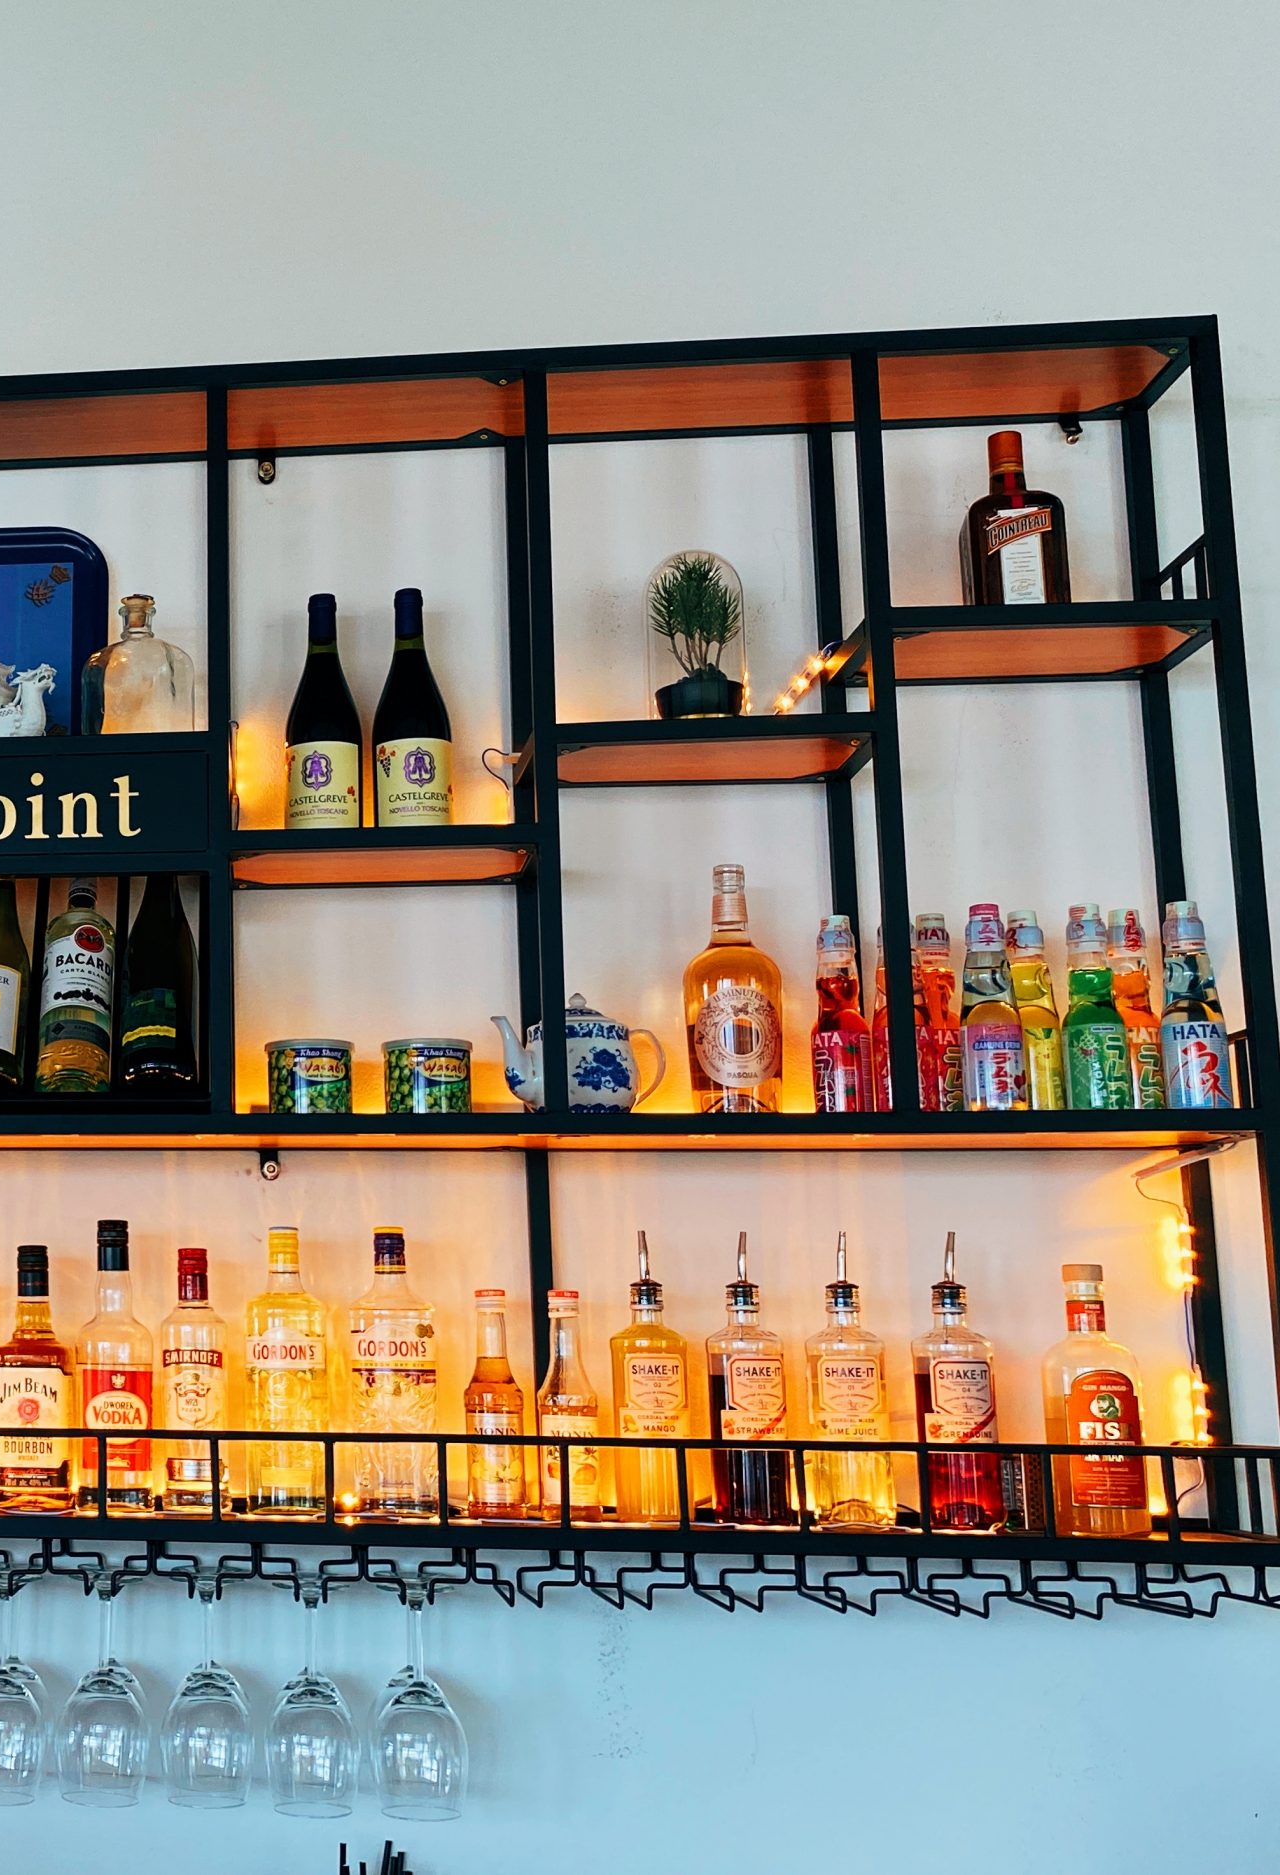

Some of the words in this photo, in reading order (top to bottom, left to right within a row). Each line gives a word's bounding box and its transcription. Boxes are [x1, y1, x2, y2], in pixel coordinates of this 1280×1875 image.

[989, 513, 1048, 546] COINTREAU
[288, 794, 348, 808] CASTELGREVE
[388, 791, 449, 803] CASTELGREVE
[289, 809, 315, 818] NOVELLO
[317, 808, 349, 817] TOSCANO
[388, 805, 421, 815] NOVELLO
[55, 953, 112, 976] BACARD
[60, 967, 85, 975] CARTA
[721, 988, 764, 1002] MINUTES
[1172, 1023, 1221, 1041] HATA
[300, 1048, 320, 1057] Khao
[423, 1048, 444, 1056] Khao
[422, 1060, 466, 1074] Wasabi
[727, 1071, 758, 1079] PASQUA
[253, 1343, 315, 1361] GORDON'S
[357, 1339, 427, 1358] GORDON'S
[164, 1350, 219, 1364] SMIRNOFF
[631, 1364, 680, 1376] SHAKE-IT
[735, 1366, 782, 1377] SHAKE-IT
[824, 1366, 875, 1378] SHAKE-IT
[938, 1369, 988, 1380] SHAKE-IT
[0, 1382, 22, 1404] JIM
[24, 1377, 58, 1404] BEAM
[1099, 1384, 1127, 1392] MANGO
[103, 1400, 134, 1410] DWOREK
[92, 1405, 143, 1426] VODKA
[473, 1427, 517, 1436] MONIN
[550, 1429, 595, 1438] MONIN
[643, 1425, 676, 1433] MANGO
[829, 1427, 850, 1436] LIME
[853, 1427, 878, 1436] JUICE
[942, 1430, 993, 1439] GRENADINE
[3, 1440, 54, 1454] BOURBON
